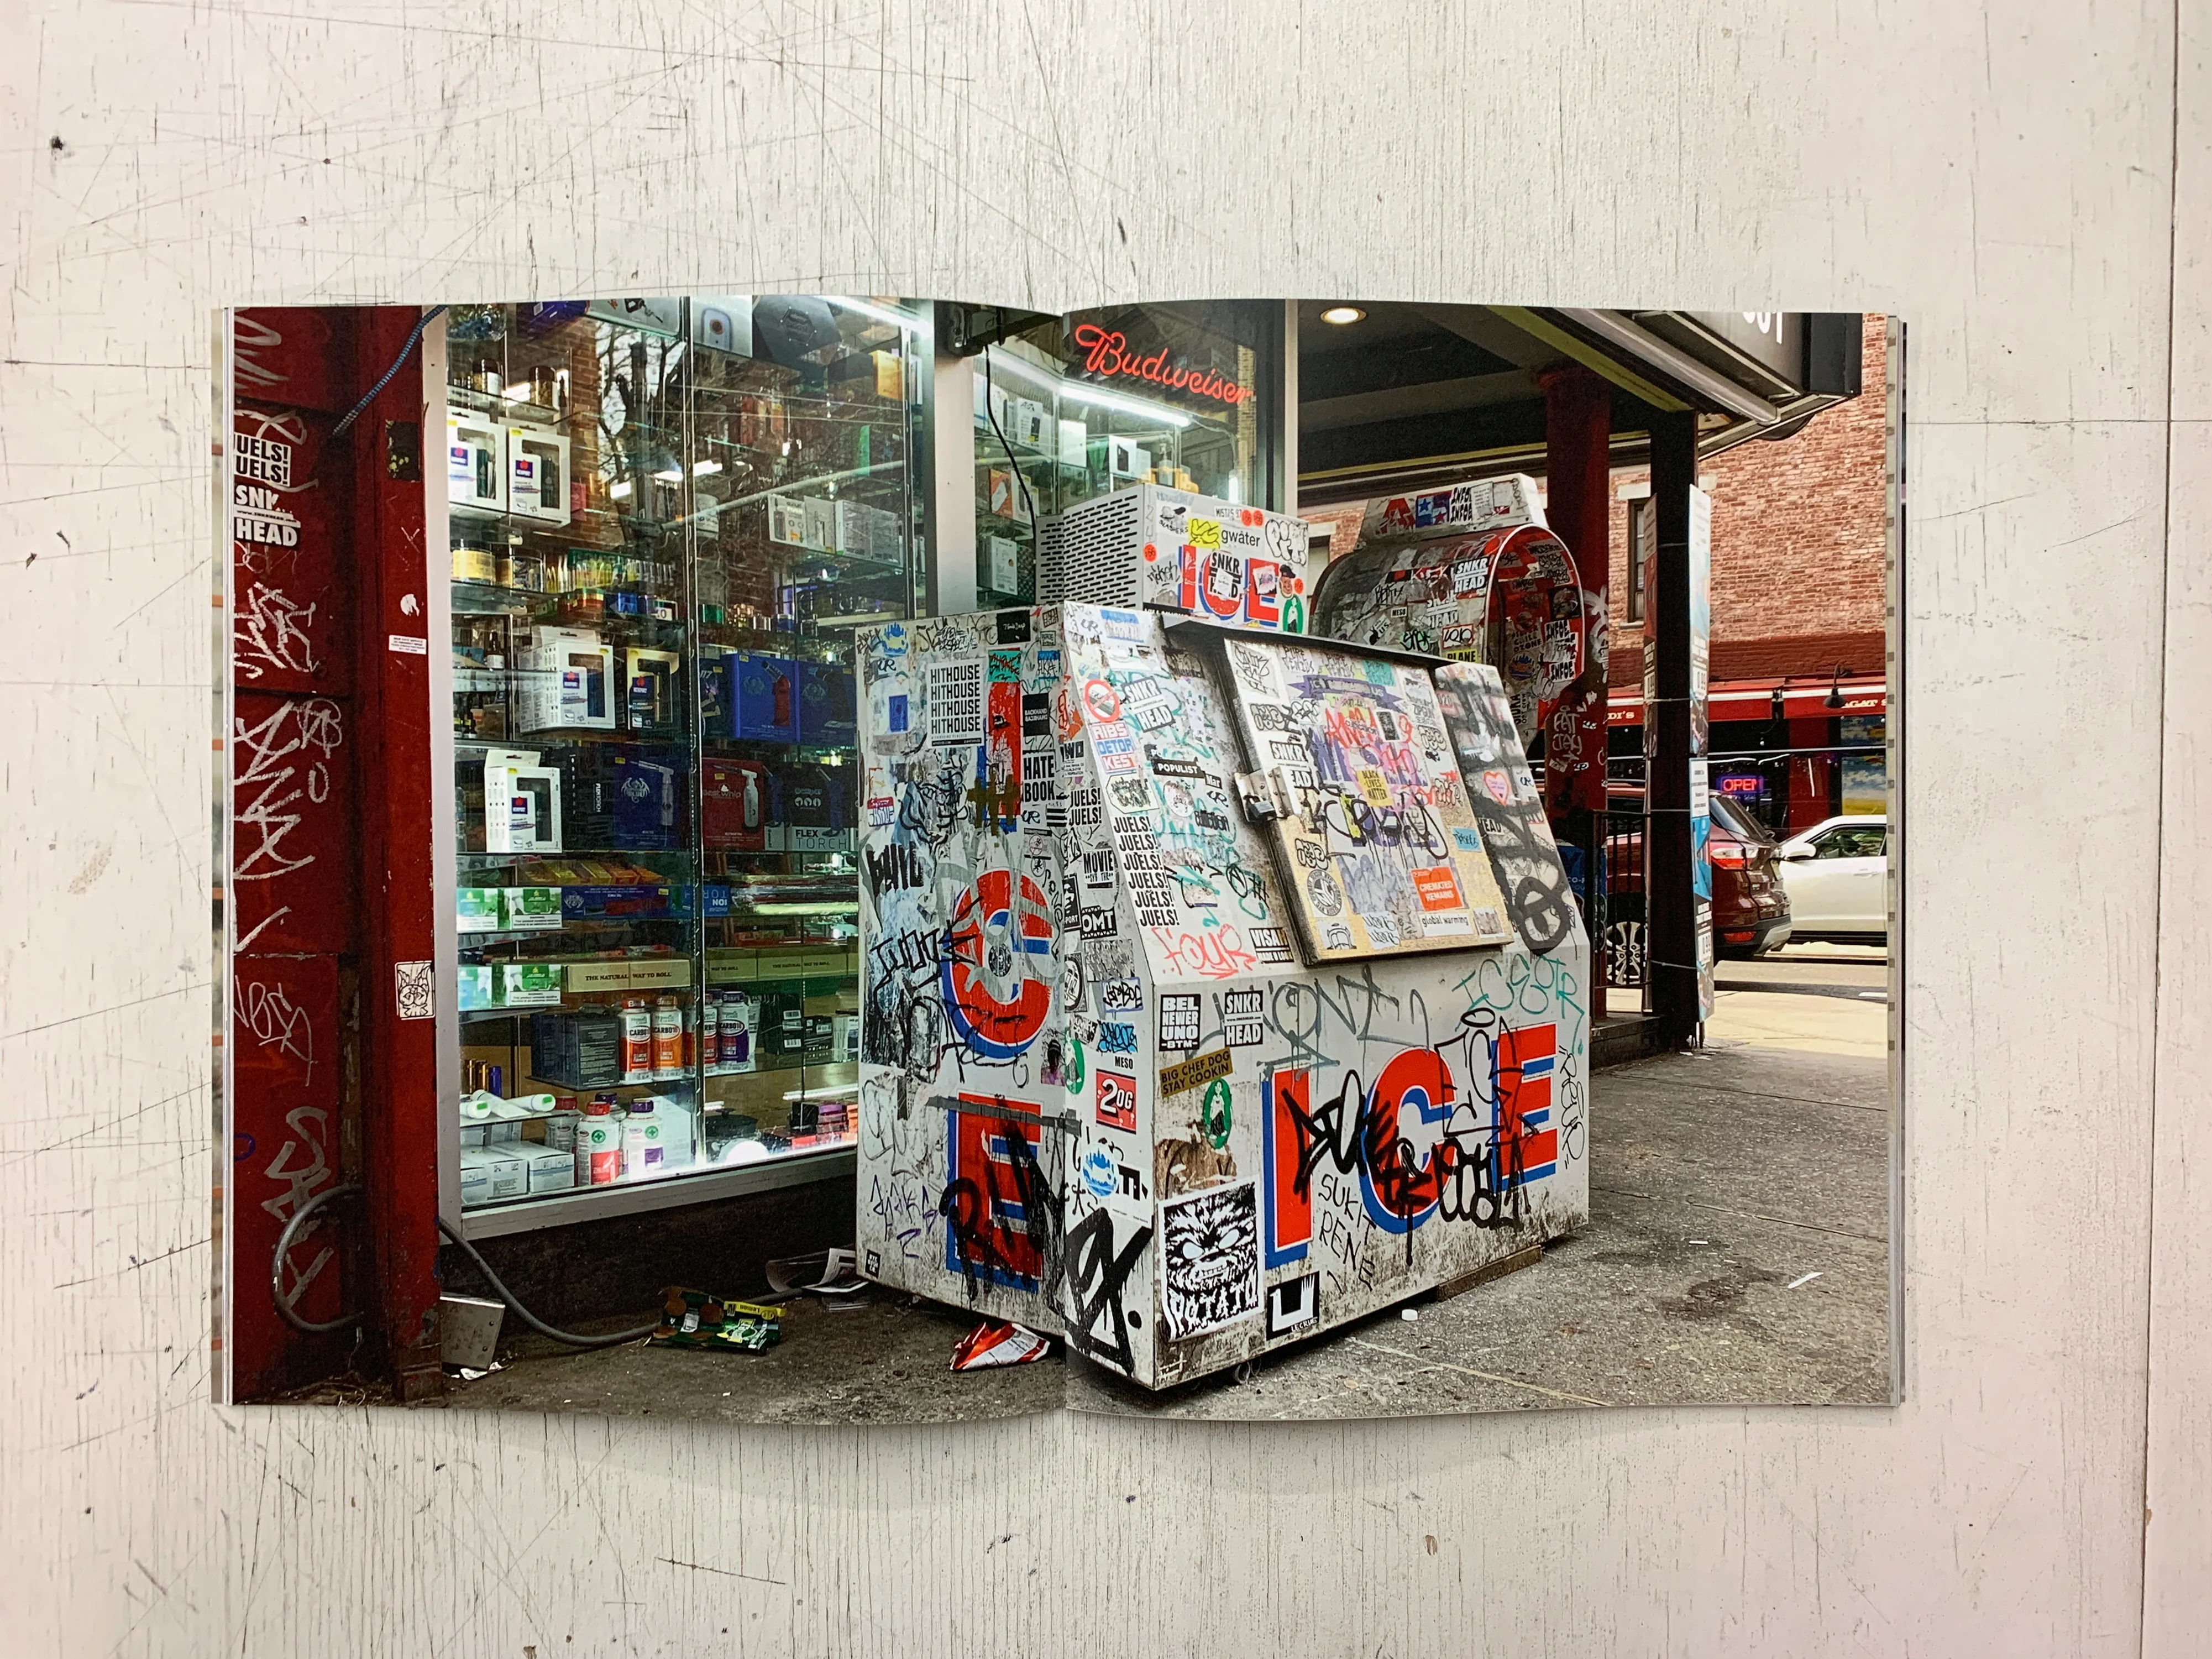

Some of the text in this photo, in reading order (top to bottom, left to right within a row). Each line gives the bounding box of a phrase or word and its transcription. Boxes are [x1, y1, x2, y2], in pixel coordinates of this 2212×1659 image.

[1075, 324, 1254, 406] Budweiser
[234, 433, 289, 465] UELS!
[235, 455, 288, 485] UELS!
[235, 485, 280, 510] SNK
[236, 518, 298, 547] HEAD
[1212, 552, 1240, 573] SNKR
[1457, 558, 1488, 574] SNKR
[1455, 575, 1486, 593] HEAD
[931, 664, 980, 684] HITHOUSE
[931, 682, 981, 701] HITHOUSE
[1124, 679, 1161, 704] SNKR
[931, 699, 981, 718] HITHOUSE
[1136, 705, 1172, 730] HEAD
[1607, 711, 1634, 721] DI'S
[931, 716, 981, 735] HITHOUSE
[1092, 724, 1127, 740] RIBS
[1272, 743, 1305, 761] SNKR
[1024, 755, 1055, 780] HATE
[1157, 763, 1198, 774] POPULIST
[1363, 770, 1380, 779] BLACK
[1291, 770, 1312, 787] EAD
[1365, 778, 1382, 788] LIVES
[1024, 781, 1056, 803] BOOK
[1070, 788, 1101, 807] JUELS!
[1367, 789, 1388, 799] MATTER
[1069, 806, 1102, 826] JUELS!
[1114, 816, 1153, 834] JUELS!
[795, 829, 819, 838] FLEX
[1119, 833, 1159, 851] JUELS!
[796, 838, 847, 850] TORCH
[1083, 850, 1114, 874] MOVIE
[1124, 852, 1163, 870] JUELS!
[1129, 871, 1169, 889] JUELS!
[1419, 880, 1454, 892] CREMATED
[1135, 889, 1175, 908] JUELS!
[1425, 890, 1455, 902] REMAINS
[1065, 915, 1078, 924] PORT
[1082, 911, 1114, 932] OMT
[1139, 908, 1180, 927] JUELS!
[1422, 915, 1469, 928] global warming
[1163, 997, 1199, 1011] BEL
[1226, 993, 1261, 1013] SNKR
[1162, 1011, 1198, 1025] NEWER
[1162, 1026, 1198, 1040] UNO
[1226, 1024, 1262, 1045] HEAD
[1115, 1055, 1134, 1069] MESO
[1161, 1050, 1231, 1084] BIG CHEF DOG
[1162, 1064, 1230, 1095] STAY COOKIN
[1262, 1023, 1559, 1270] ICE
